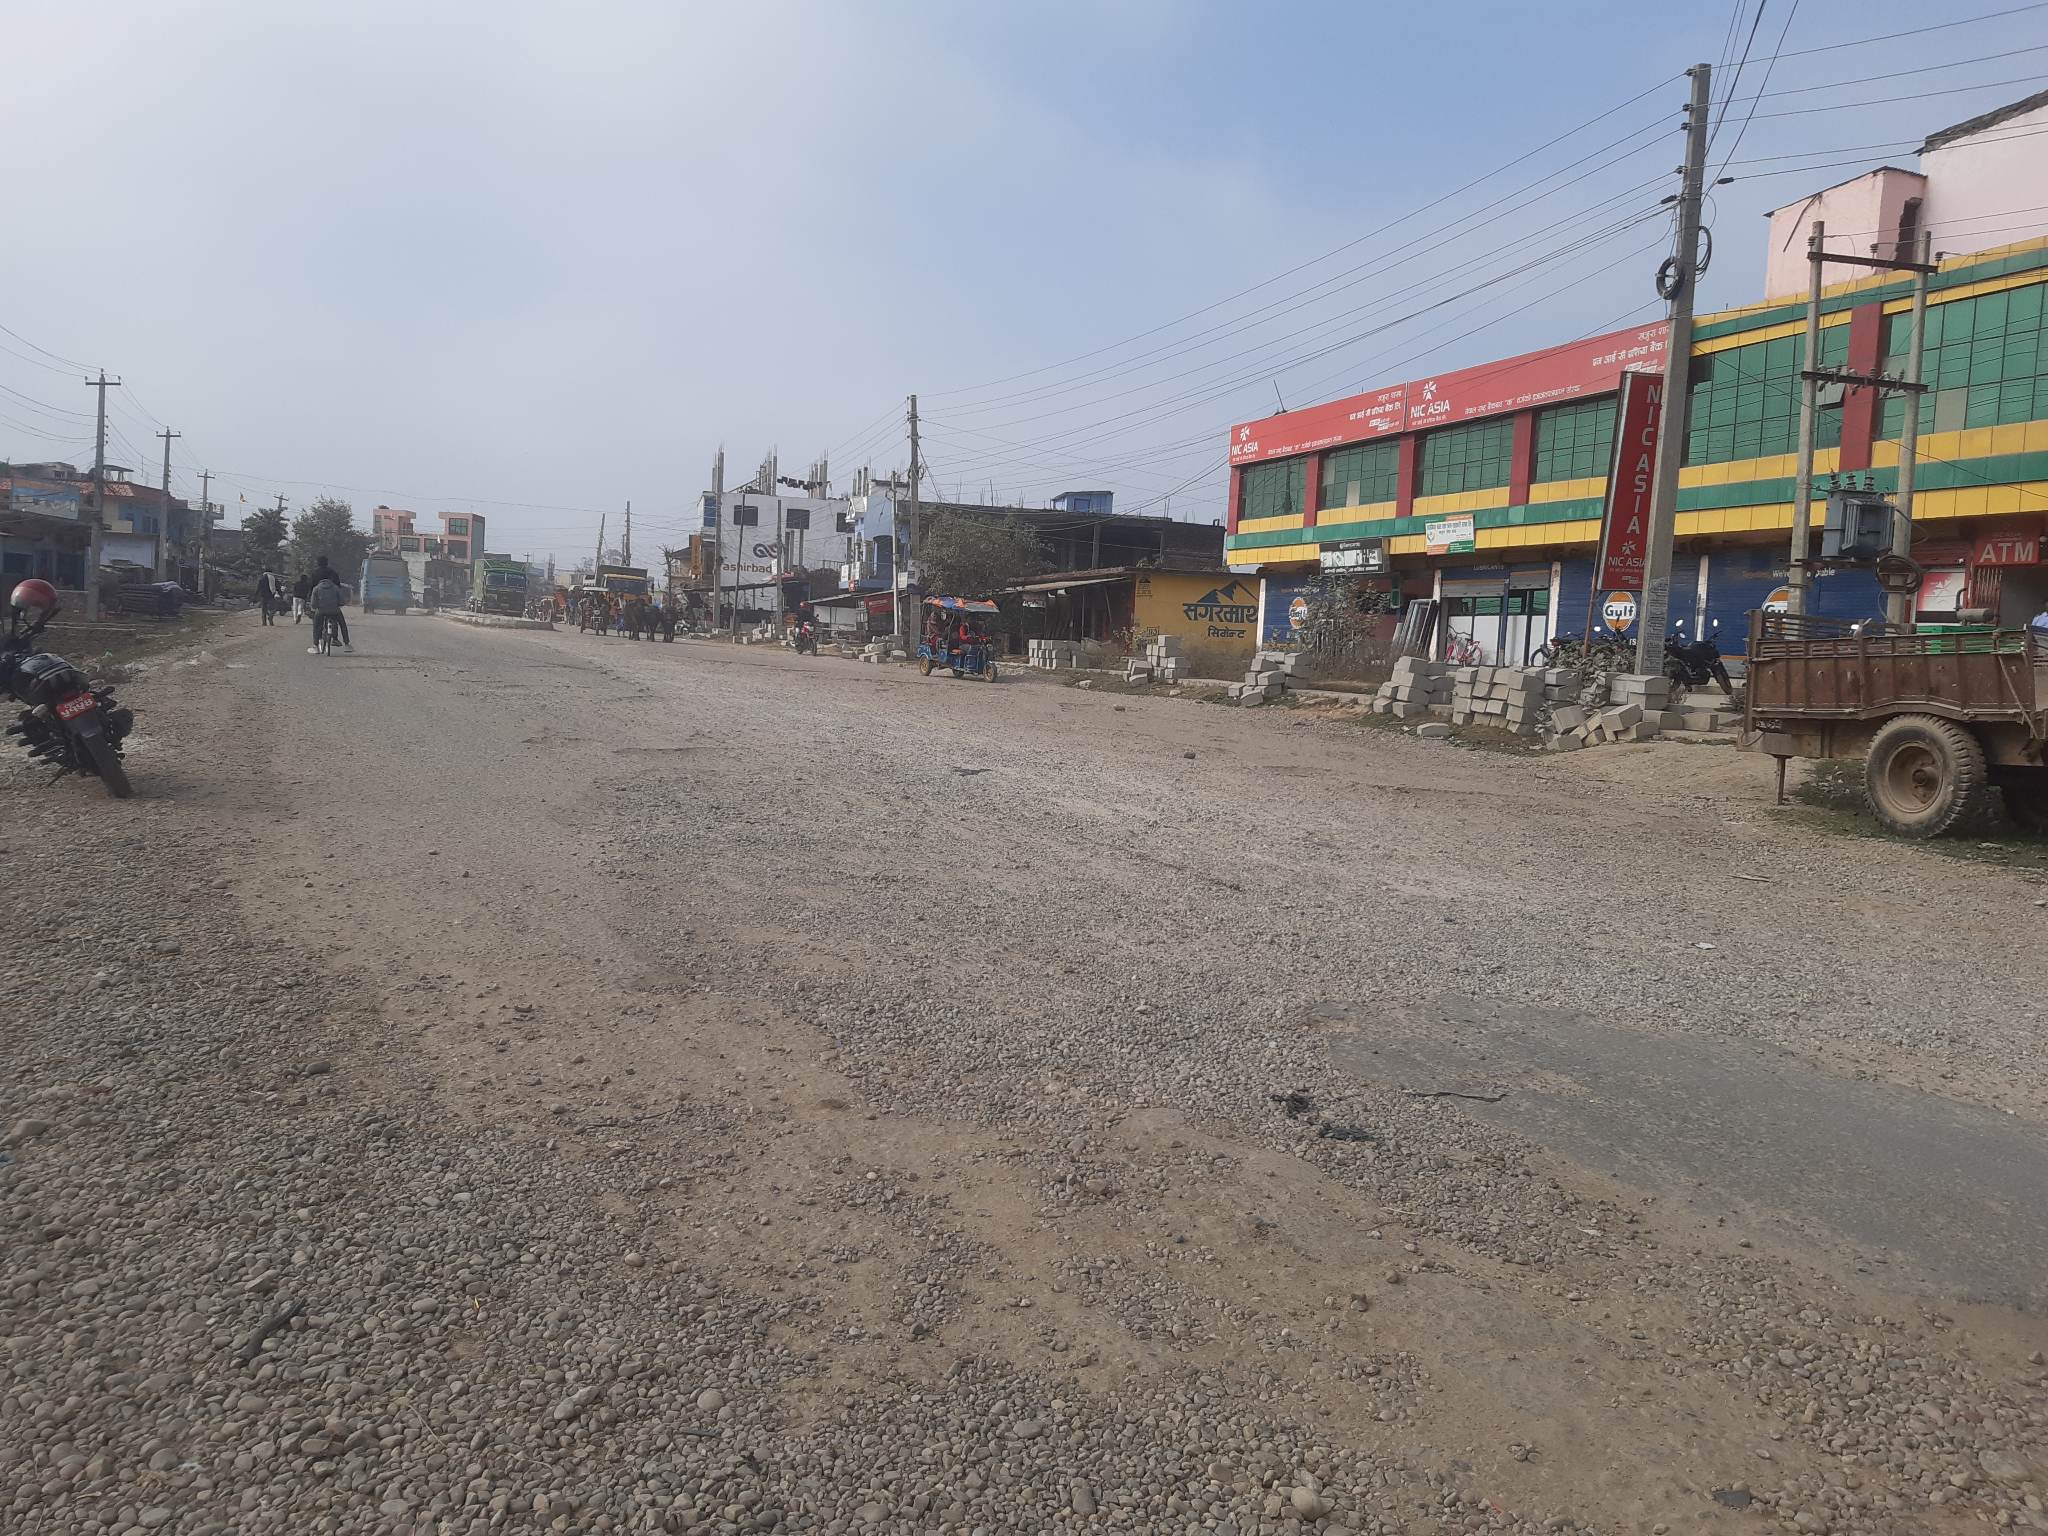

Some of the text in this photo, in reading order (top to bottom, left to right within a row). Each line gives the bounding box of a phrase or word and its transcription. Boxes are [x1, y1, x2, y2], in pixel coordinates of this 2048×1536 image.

[1410, 399, 1451, 418] NIC ASIA
[1231, 444, 1243, 456] NIC
[1243, 441, 1259, 454] ASIA
[1980, 543, 2033, 562] ATM
[722, 563, 773, 574] ashirbad
[1608, 556, 1625, 567] NIC
[1605, 604, 1635, 617] Gulf
